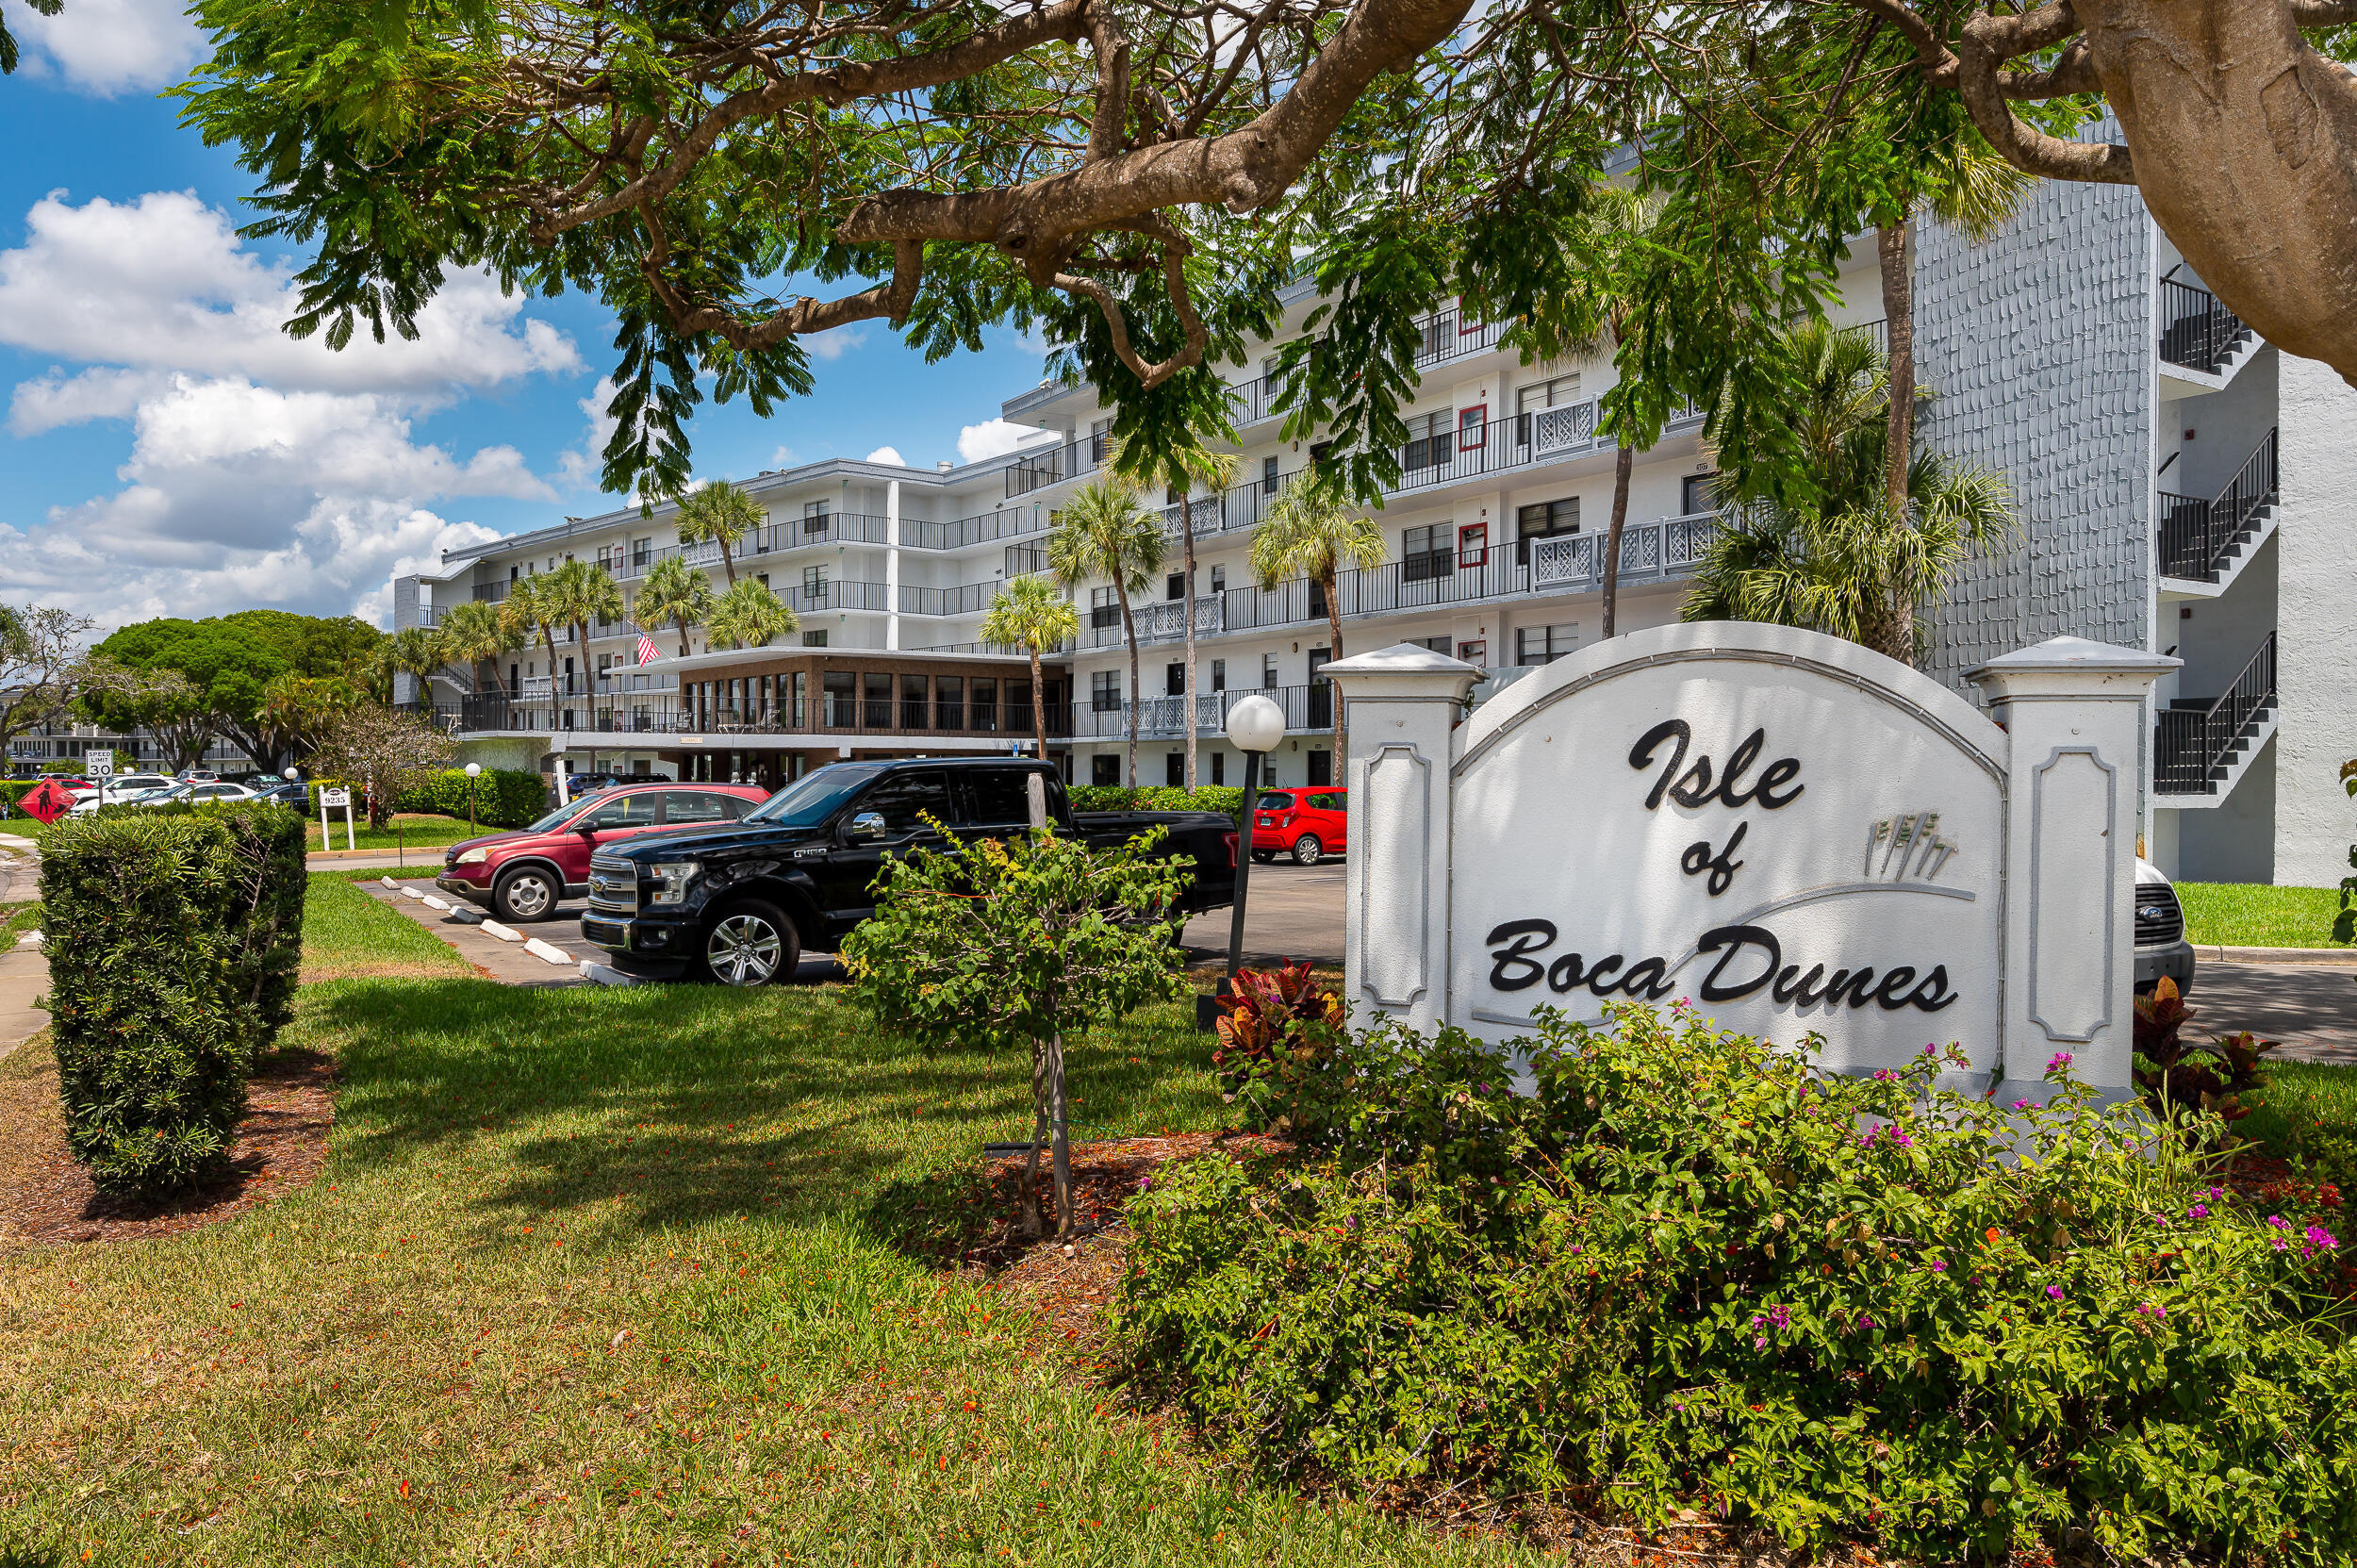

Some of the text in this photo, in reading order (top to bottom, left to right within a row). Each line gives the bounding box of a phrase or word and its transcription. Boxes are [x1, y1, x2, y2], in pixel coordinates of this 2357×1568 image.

[90, 765, 110, 775] 30
[1628, 718, 1805, 811] Isle
[1681, 821, 1748, 897] of
[1486, 918, 1958, 1013] Boca Dunes
